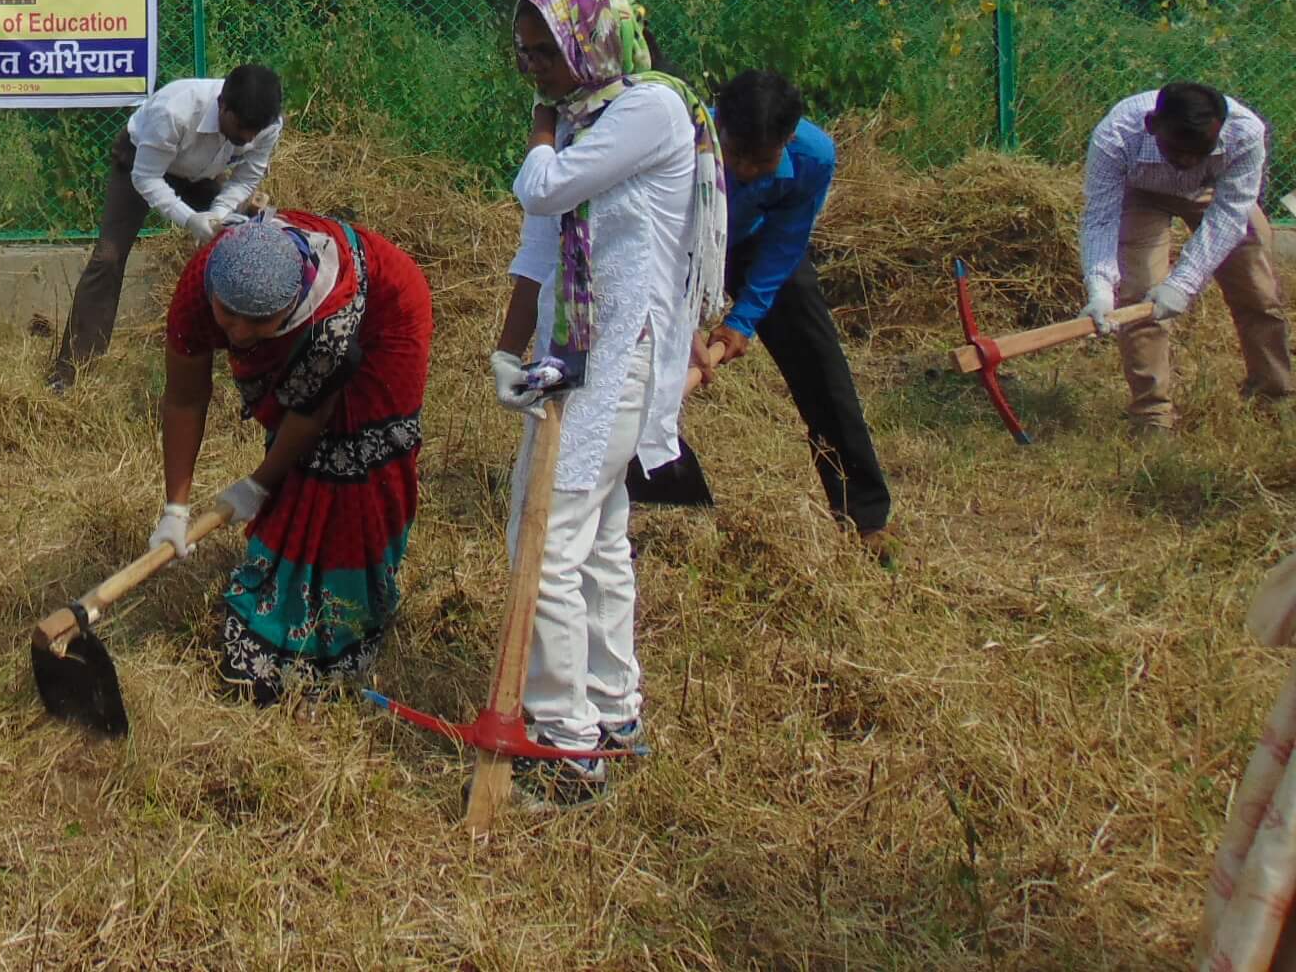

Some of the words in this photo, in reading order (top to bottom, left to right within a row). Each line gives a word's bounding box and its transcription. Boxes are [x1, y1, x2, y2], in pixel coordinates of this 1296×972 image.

[3, 12, 23, 33] of
[29, 12, 128, 33] Education
[29, 40, 135, 76] अभियान
